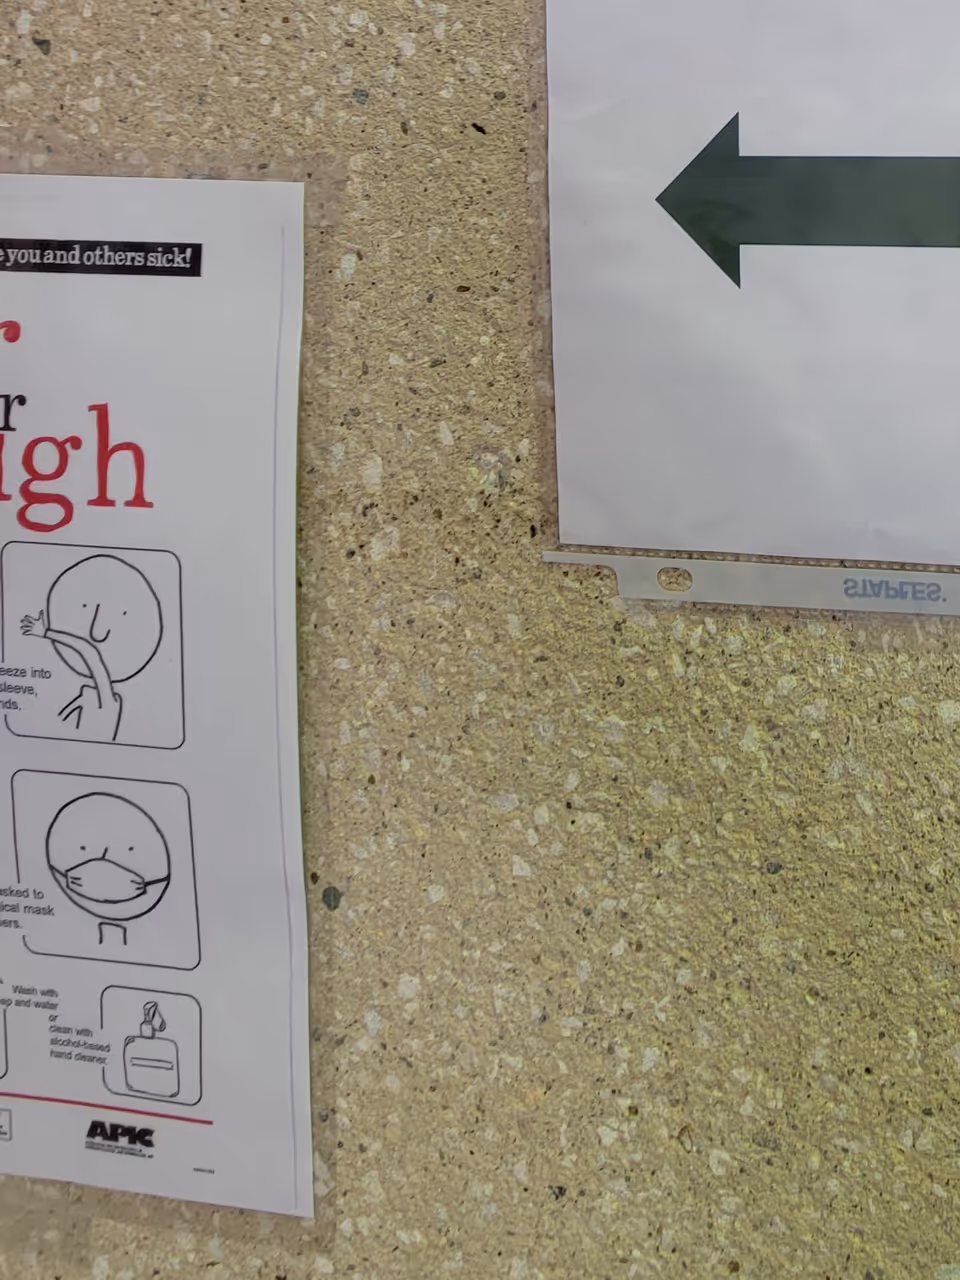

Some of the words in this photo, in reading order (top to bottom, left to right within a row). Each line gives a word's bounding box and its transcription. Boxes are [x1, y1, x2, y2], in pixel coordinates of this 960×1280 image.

[6, 248, 41, 267] you
[43, 244, 81, 264] and
[83, 245, 145, 267] others
[146, 247, 193, 269] sick!
[31, 666, 52, 680] into
[33, 888, 45, 900] to
[86, 1119, 156, 1148] APIC
